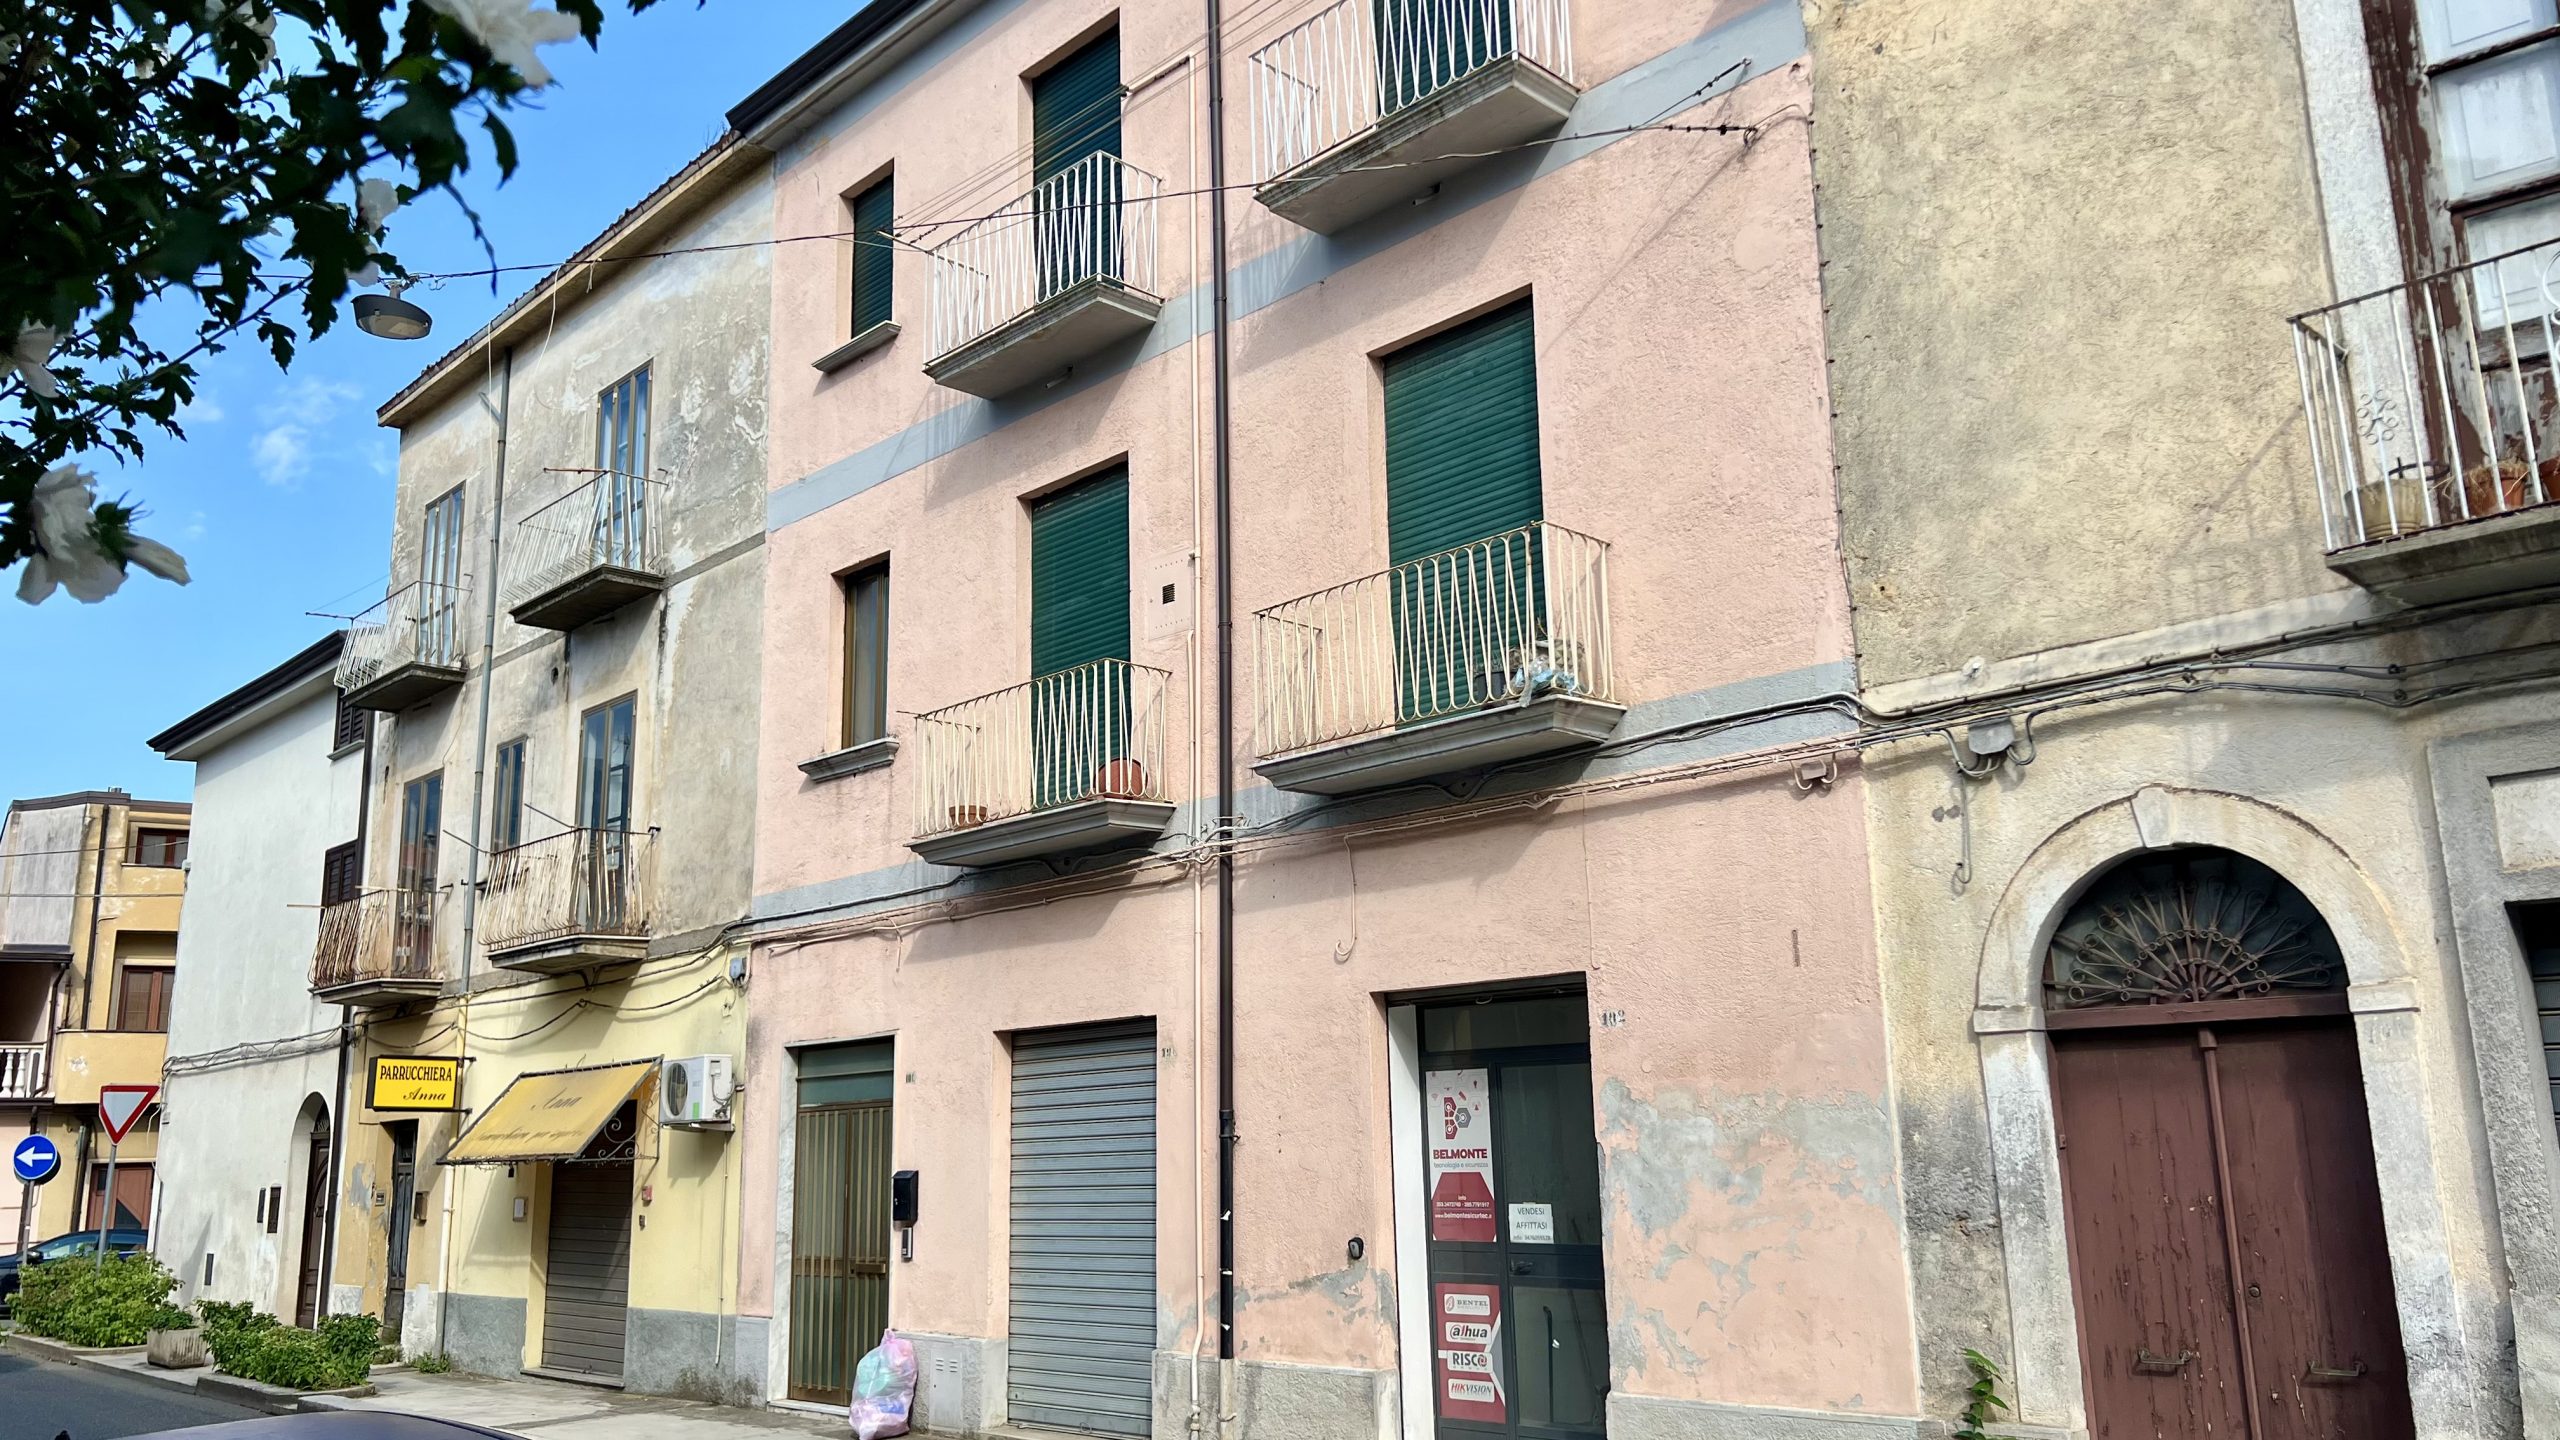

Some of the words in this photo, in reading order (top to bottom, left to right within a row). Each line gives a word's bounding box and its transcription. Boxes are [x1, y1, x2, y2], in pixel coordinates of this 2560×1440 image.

[380, 1065, 452, 1081] PARRUCCHIERA
[403, 1087, 446, 1101] Anna
[1433, 1149, 1487, 1159] BELMONTE
[1434, 1161, 1460, 1169] tecnologia
[1516, 1221, 1547, 1230] AFFITTASI
[1457, 1299, 1488, 1307] BENTEL
[1452, 1352, 1488, 1367] RISCO
[1451, 1382, 1492, 1393] HIKVISION
